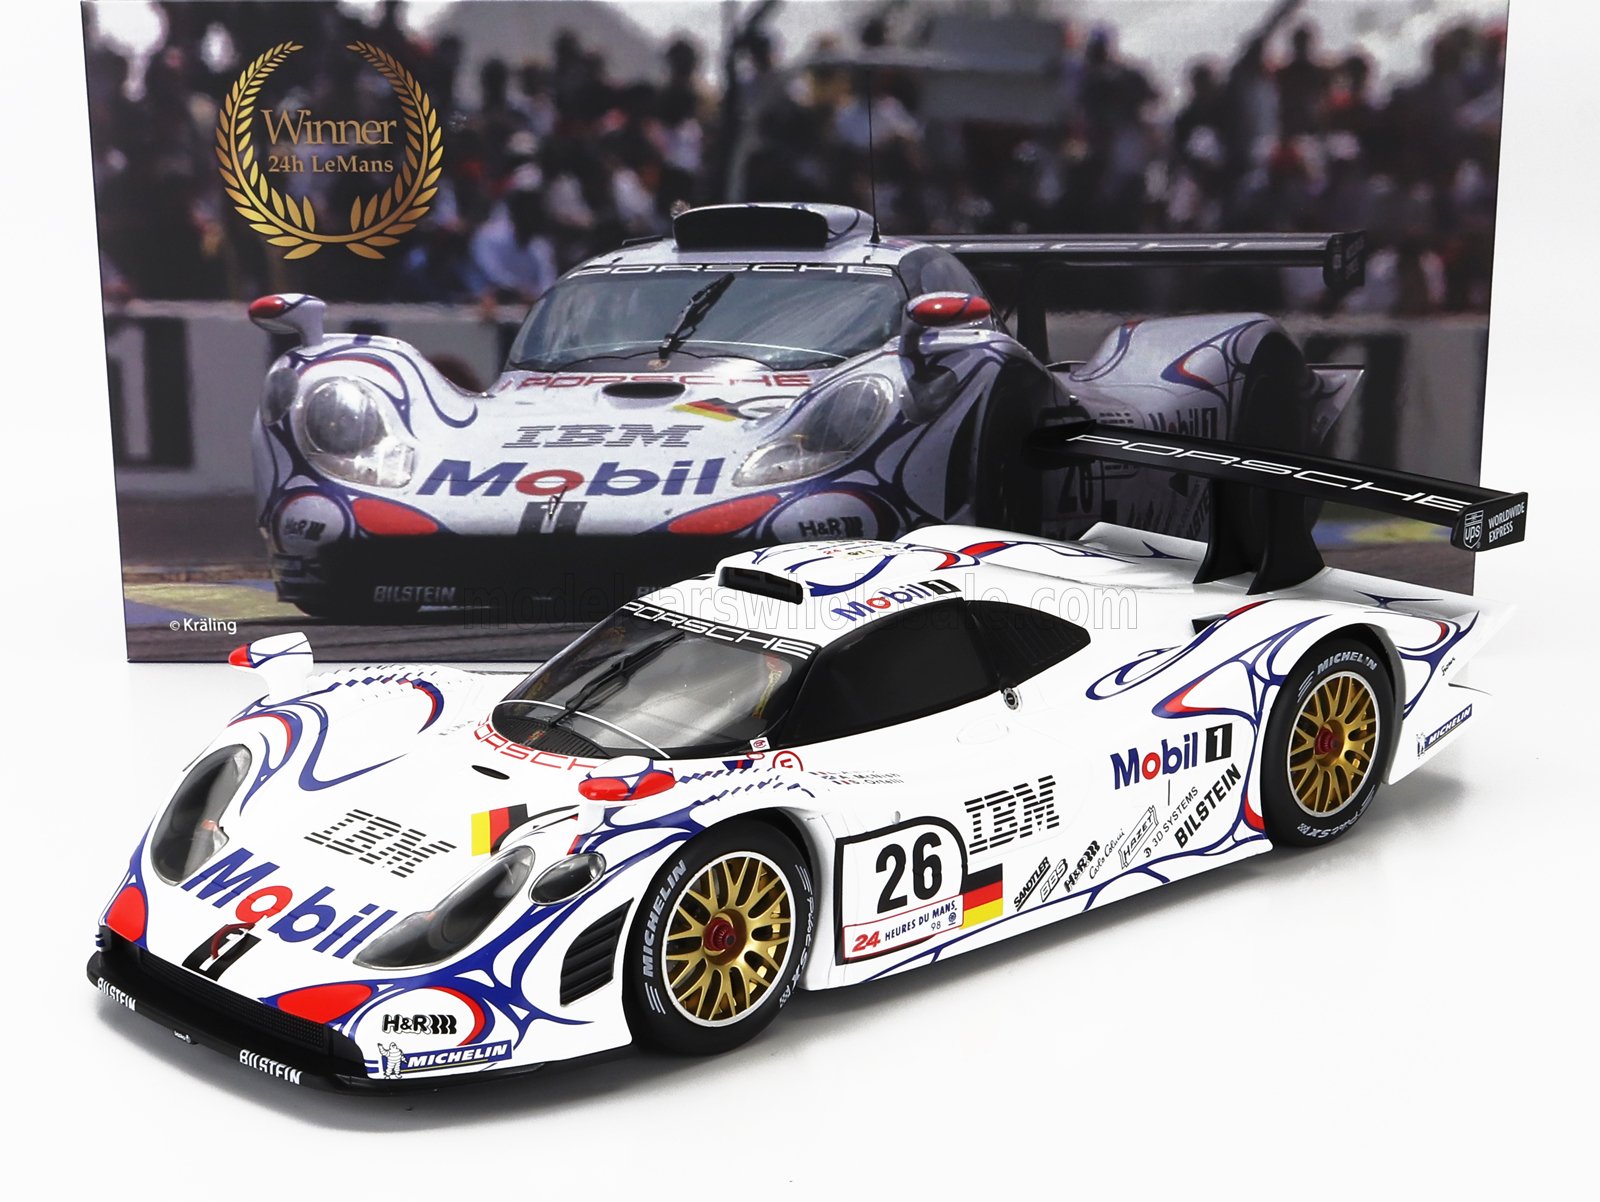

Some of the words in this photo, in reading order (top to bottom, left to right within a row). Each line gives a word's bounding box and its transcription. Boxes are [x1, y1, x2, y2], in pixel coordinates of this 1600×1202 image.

[260, 108, 397, 146] Winner
[268, 154, 304, 173] 24h
[312, 154, 394, 173] LeMans
[566, 263, 894, 279] PORSCHE
[519, 374, 811, 388] PORSCHE
[502, 424, 704, 449] IBM
[416, 457, 726, 497] Mobil
[1065, 433, 1473, 513] PORSCHE
[1487, 501, 1526, 530] WORLDWIDE
[1488, 520, 1514, 543] EXPRESS
[373, 585, 457, 603] BILSTEIN
[831, 583, 933, 622] Mobil
[183, 617, 238, 636] Kräling
[620, 601, 818, 660] PORSCHE
[1428, 706, 1472, 746] MICHELIN
[1109, 731, 1198, 791] Mobil
[964, 774, 1060, 855] IBM
[1163, 786, 1199, 833] SYSTEMS
[1174, 763, 1242, 849] BILSTEIN
[303, 808, 457, 878] IBM
[1122, 814, 1155, 863] HAZET
[875, 831, 943, 914] 26
[1013, 856, 1051, 911] SANDTLER
[1040, 858, 1069, 903] BBS
[180, 846, 398, 960] Mobil
[642, 859, 687, 978] MICHELIN
[852, 930, 882, 953] 24
[884, 919, 916, 942] HEURES
[918, 913, 930, 926] DU
[930, 920, 942, 932] 98
[97, 977, 137, 1012] BILSTEIN
[382, 1014, 432, 1035] H&R
[239, 1049, 303, 1086] BILSTEIN
[407, 1043, 508, 1069] MICHELIN
